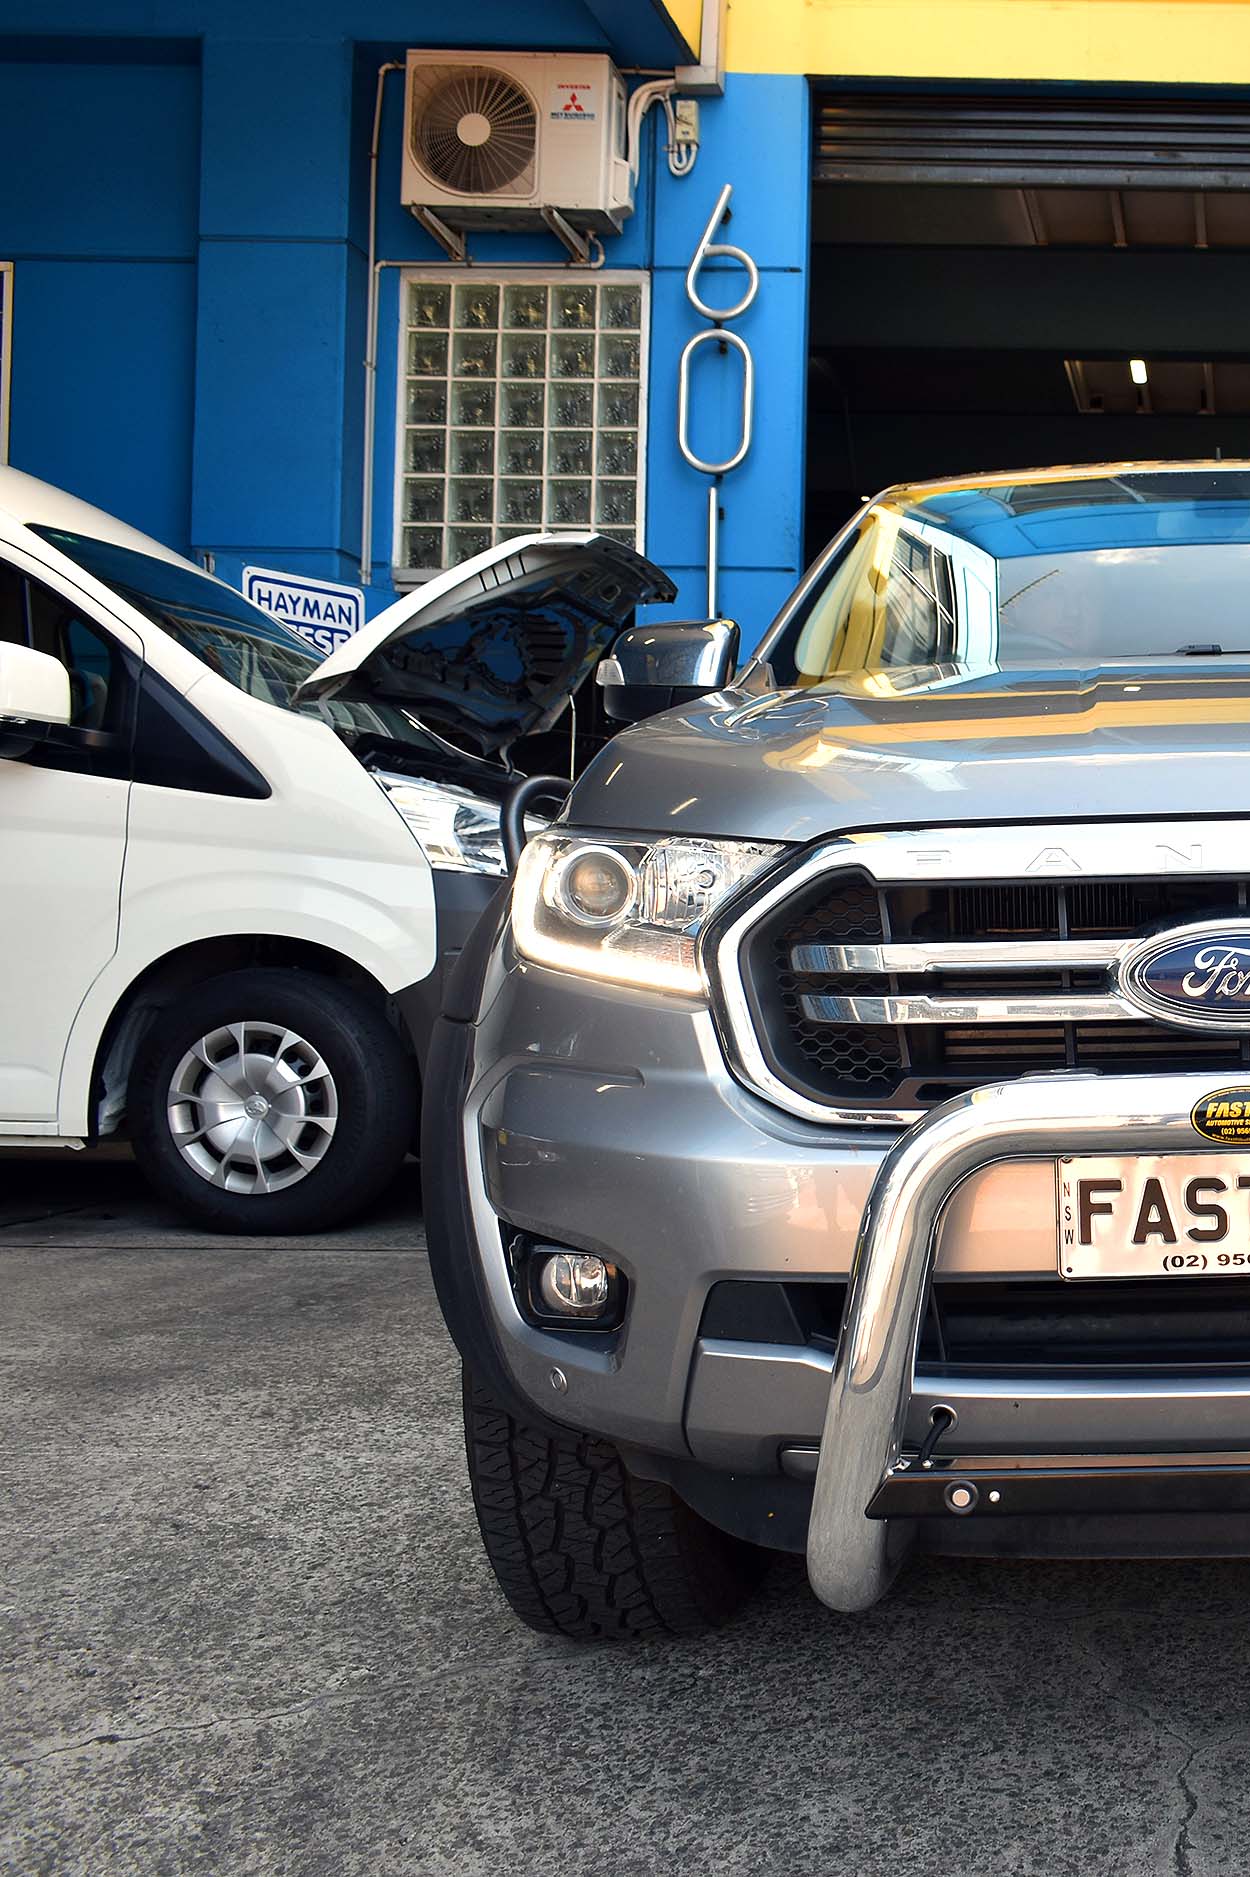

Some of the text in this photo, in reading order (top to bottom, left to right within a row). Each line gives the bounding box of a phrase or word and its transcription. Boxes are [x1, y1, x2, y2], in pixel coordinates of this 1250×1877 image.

[257, 588, 352, 626] HAYMAN
[1206, 1119, 1245, 1127] AUTOMOTIVE
[1221, 1127, 1236, 1135] (02)
[1162, 1254, 1208, 1271] (02)
